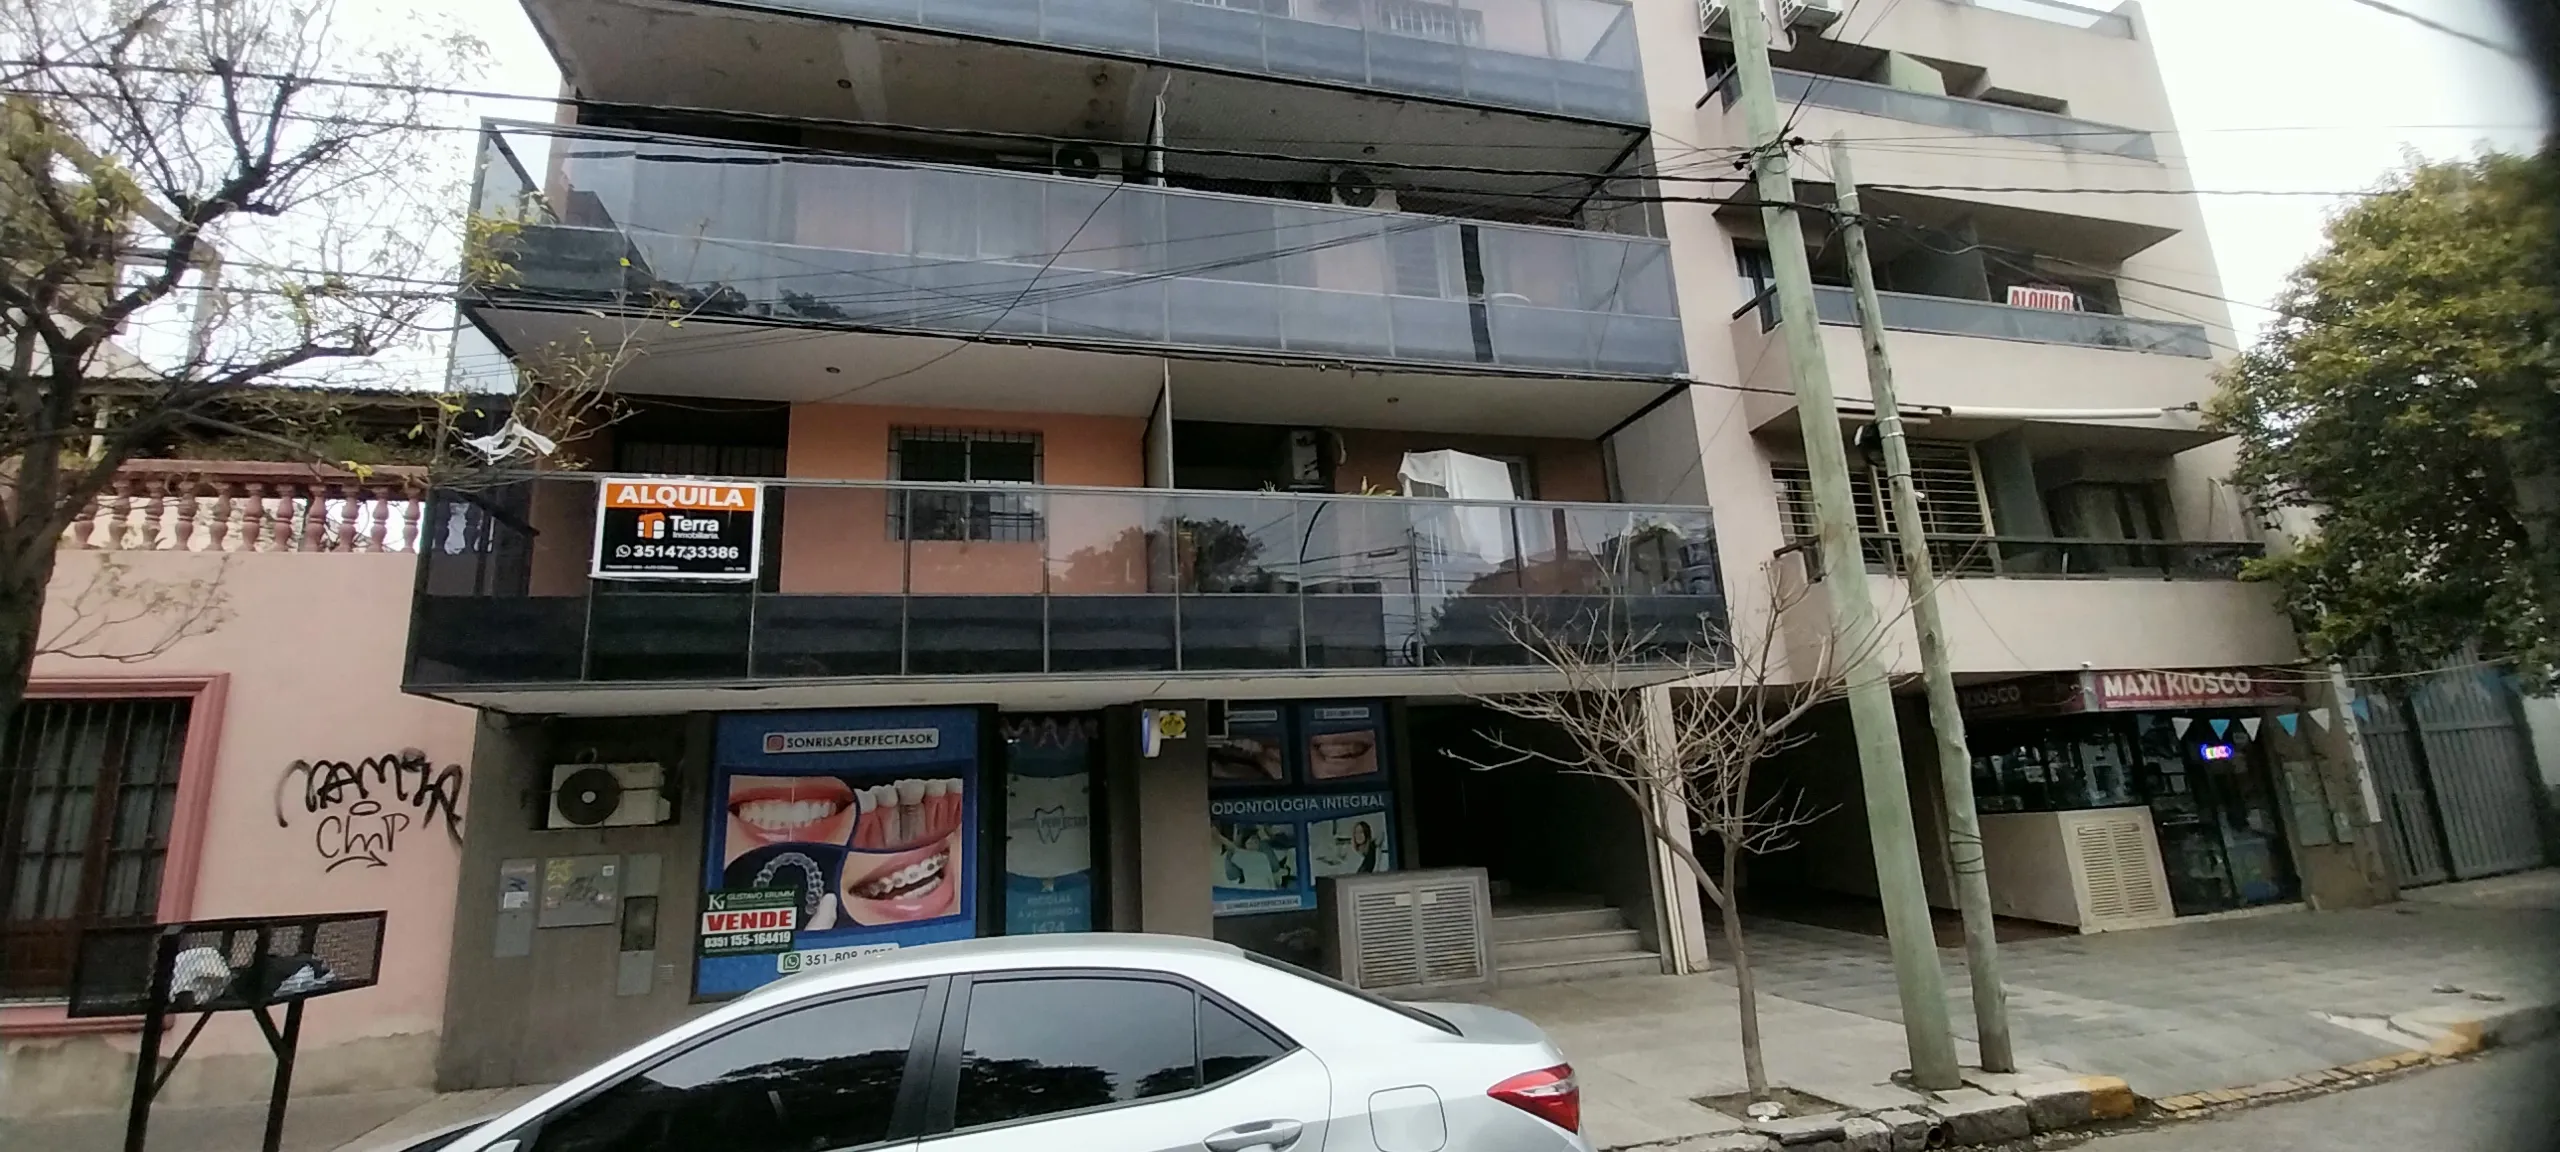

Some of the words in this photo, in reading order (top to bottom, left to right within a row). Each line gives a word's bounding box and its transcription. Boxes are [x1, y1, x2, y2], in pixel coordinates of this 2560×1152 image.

[617, 486, 745, 507] ALQUILA
[669, 515, 719, 532] Terra
[633, 544, 739, 560] 3514733386
[2101, 674, 2162, 697] MAXI
[2164, 671, 2251, 697] KIOSCO
[787, 733, 934, 749] SONRISASPERFECTASOK
[1211, 797, 1320, 815] ODONTOLOGIA
[1322, 794, 1384, 810] INTEGRAL
[727, 892, 762, 900] GUSTAVO
[764, 890, 795, 899] KRUMM
[707, 910, 792, 932] VENDE
[730, 931, 791, 946] 155-164419
